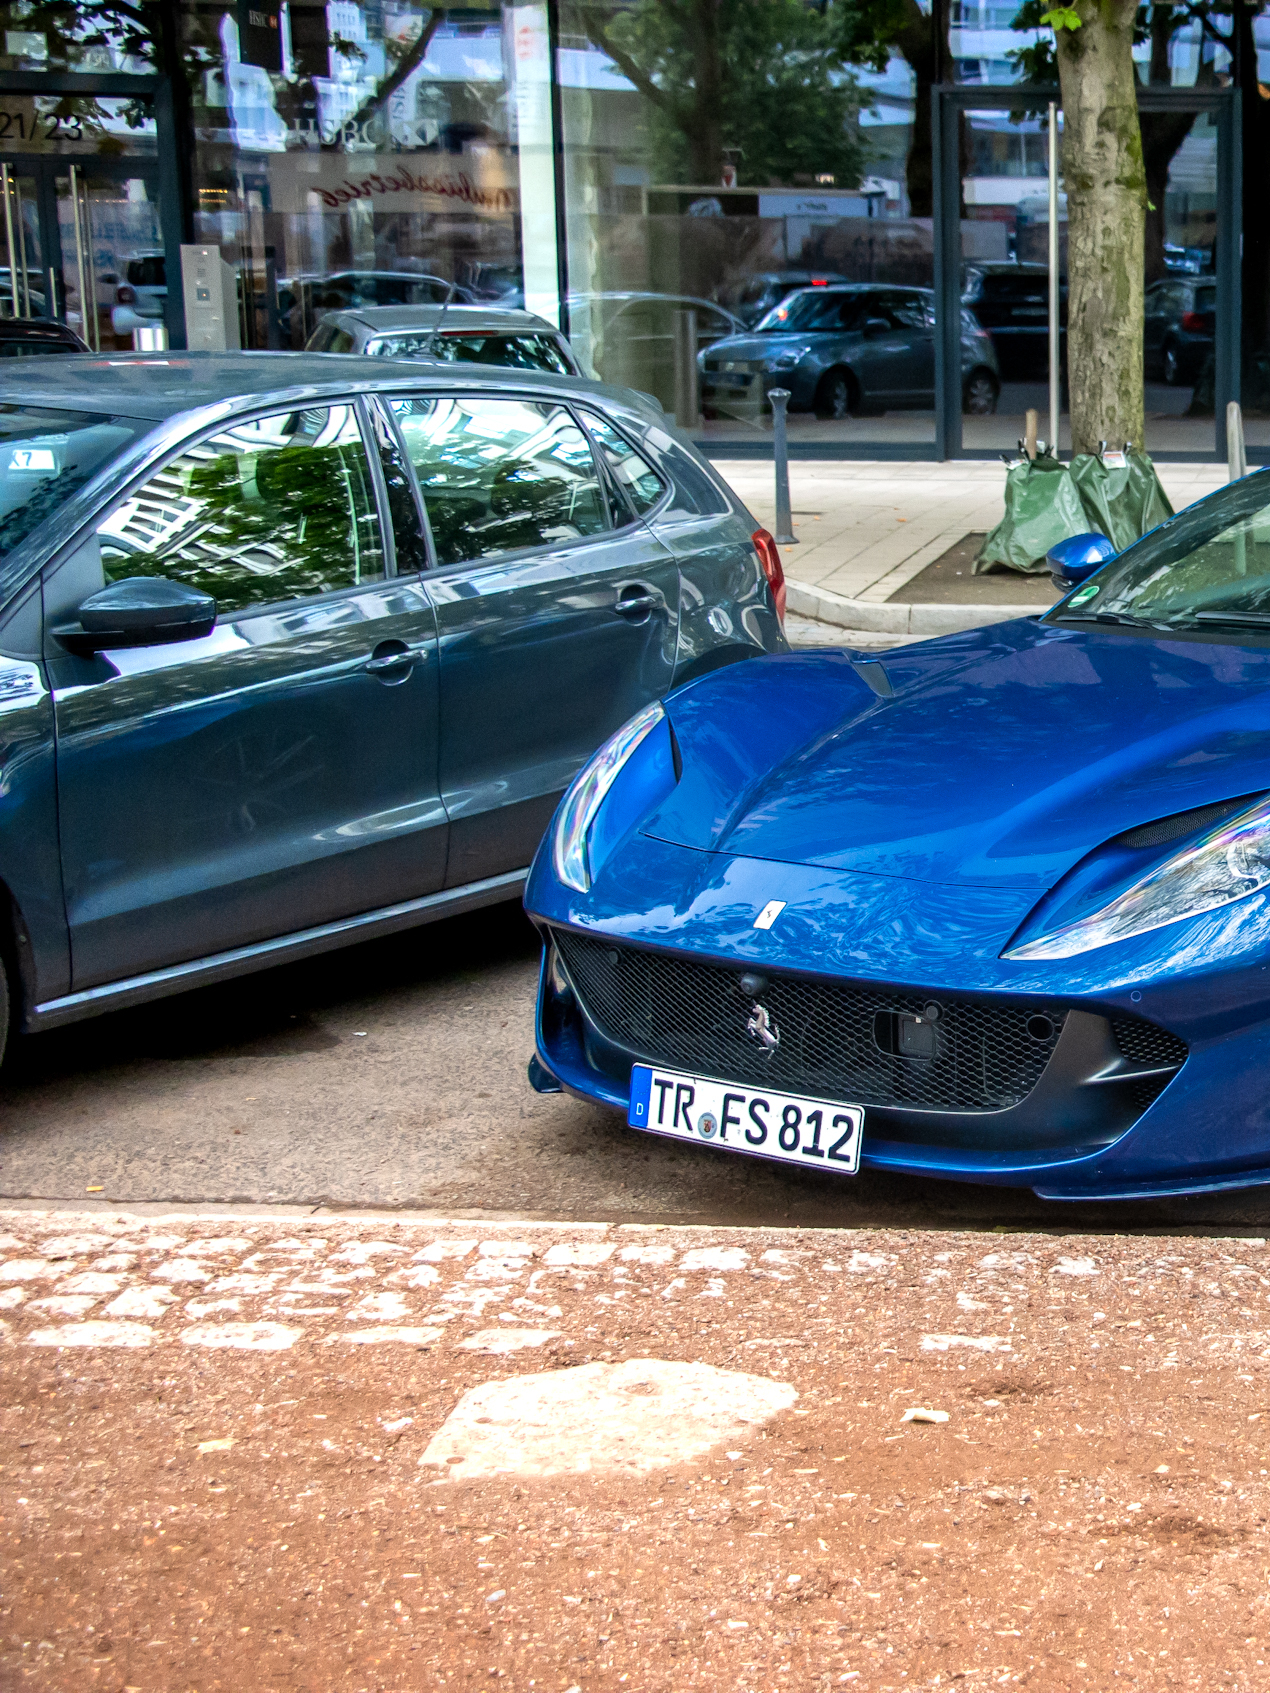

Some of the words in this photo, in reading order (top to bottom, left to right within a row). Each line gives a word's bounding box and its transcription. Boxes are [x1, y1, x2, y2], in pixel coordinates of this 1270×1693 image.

[0, 110, 83, 142] 21/23
[292, 117, 383, 146] HSBC
[635, 1102, 645, 1116] D
[653, 1077, 695, 1132] TR
[719, 1092, 771, 1146] FS
[778, 1103, 855, 1163] 812
